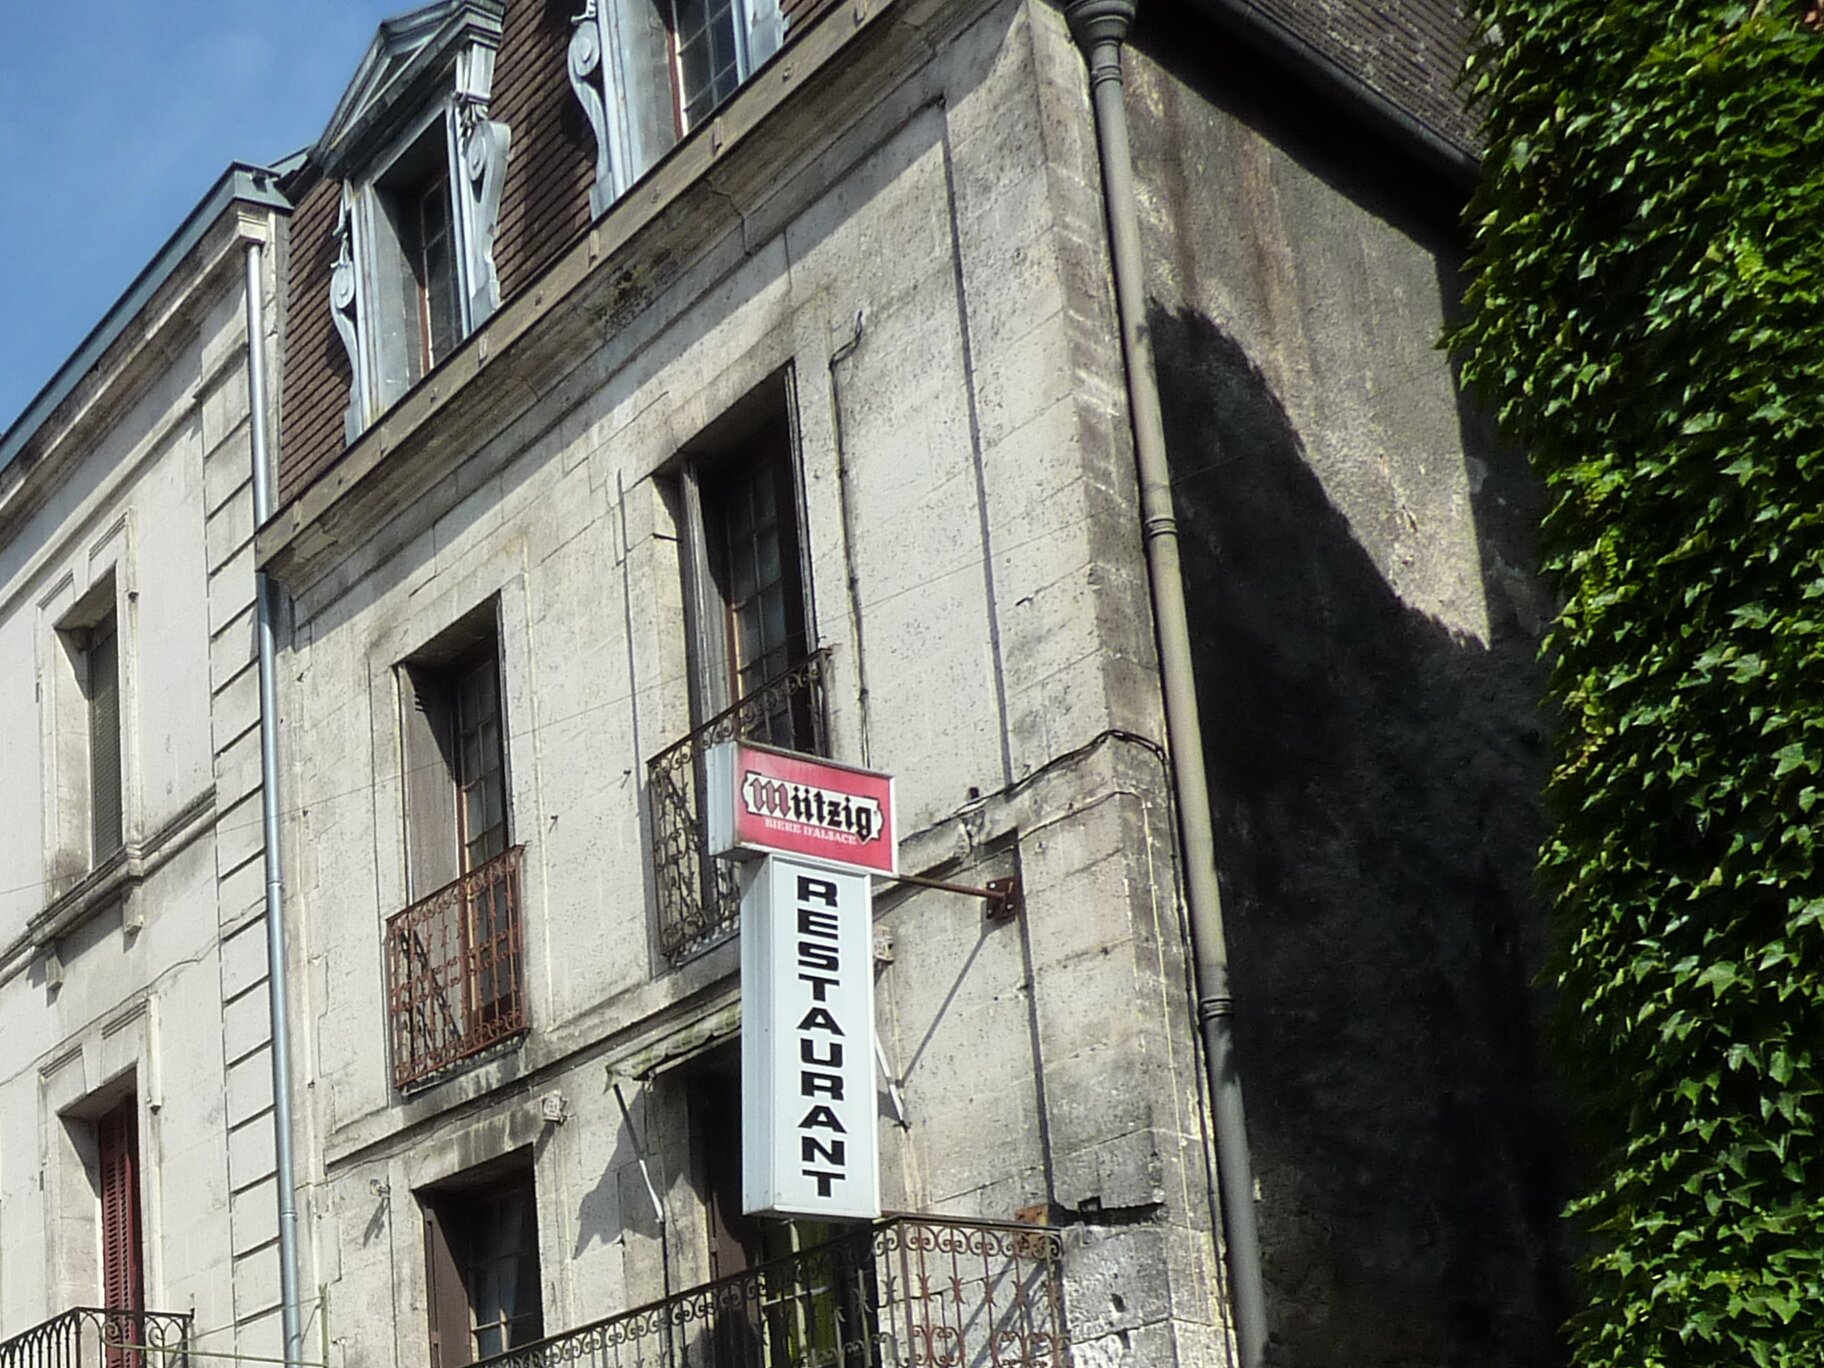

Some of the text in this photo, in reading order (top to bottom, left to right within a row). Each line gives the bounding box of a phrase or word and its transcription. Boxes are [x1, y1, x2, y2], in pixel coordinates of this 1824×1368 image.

[765, 818, 857, 845] BIERE D'ALSACE
[797, 875, 847, 1198] RESTAURANT
